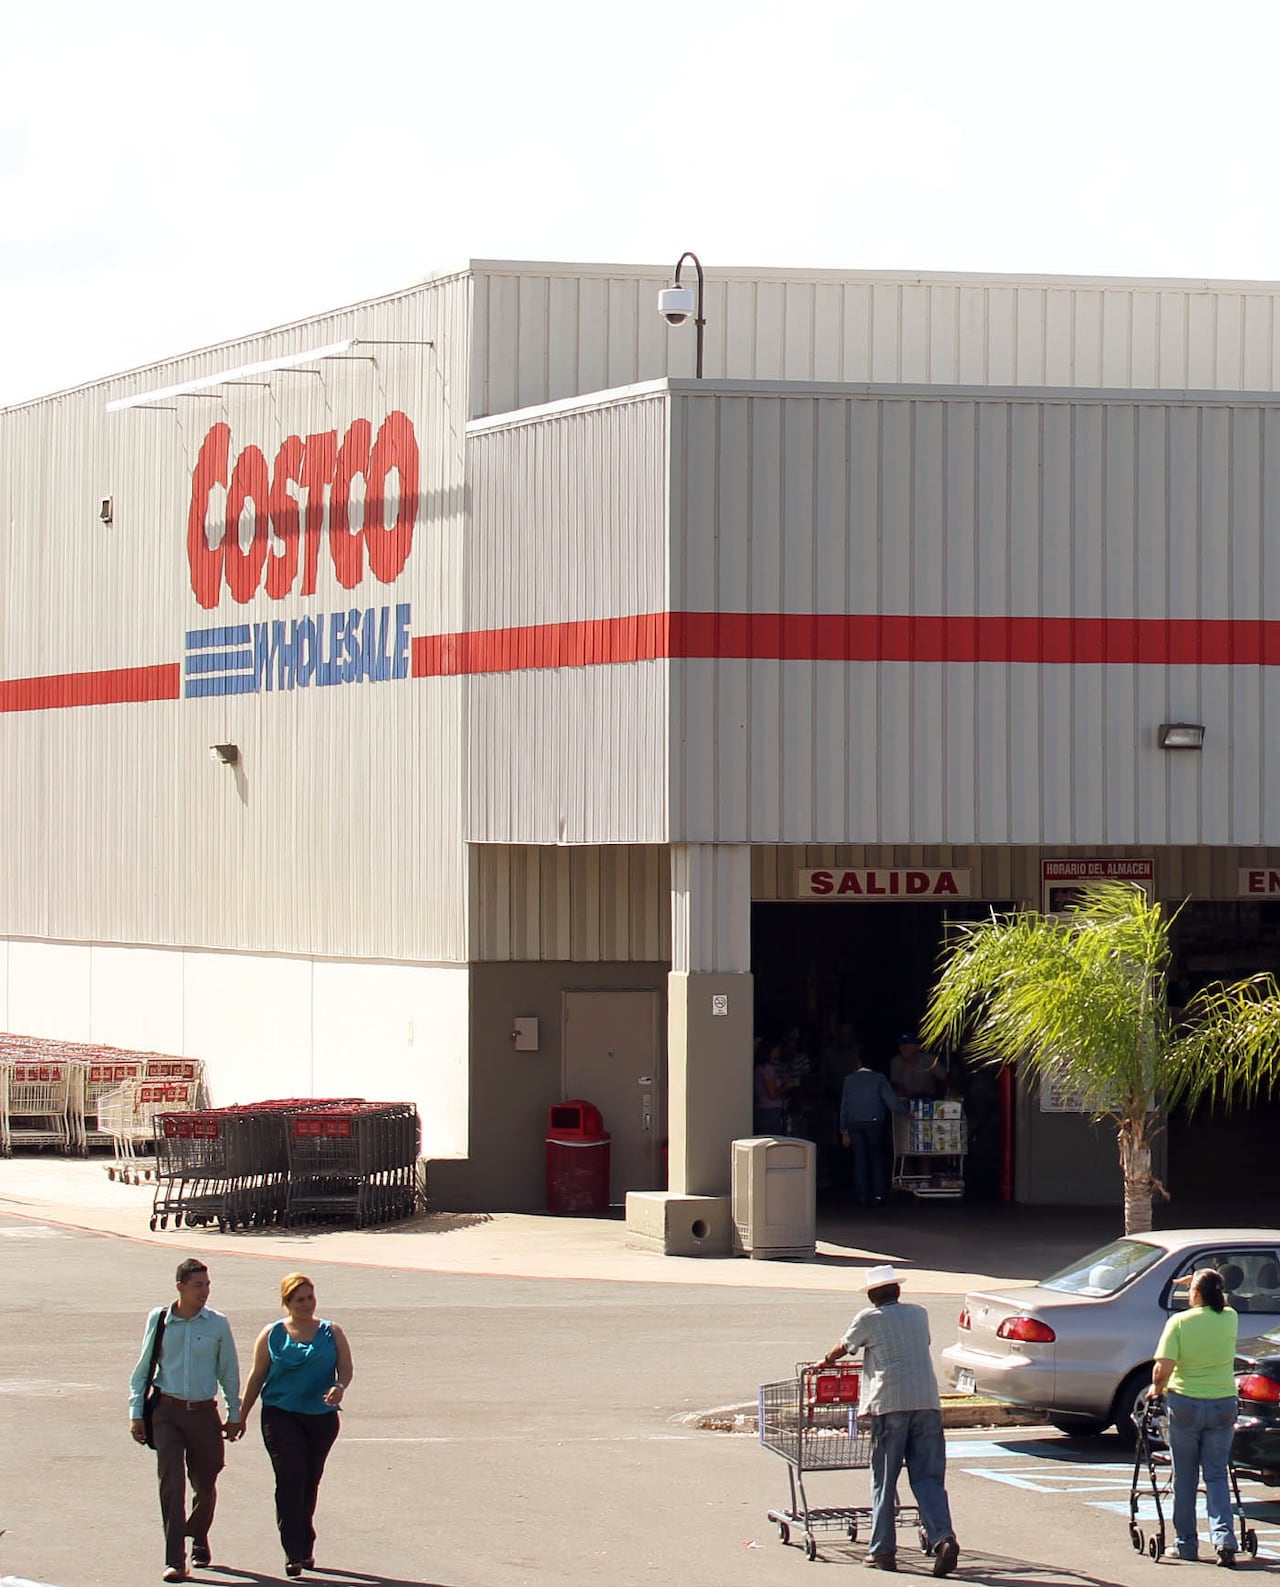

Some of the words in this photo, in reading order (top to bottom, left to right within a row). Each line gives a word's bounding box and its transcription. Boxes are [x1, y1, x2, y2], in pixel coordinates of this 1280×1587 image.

[187, 411, 419, 609] COSTCO
[253, 603, 411, 692] WHOLESALE
[810, 871, 959, 895] SALIDA
[1046, 863, 1086, 875] HORARIO
[1088, 863, 1105, 875] DEL
[1107, 863, 1151, 875] ALMACEN
